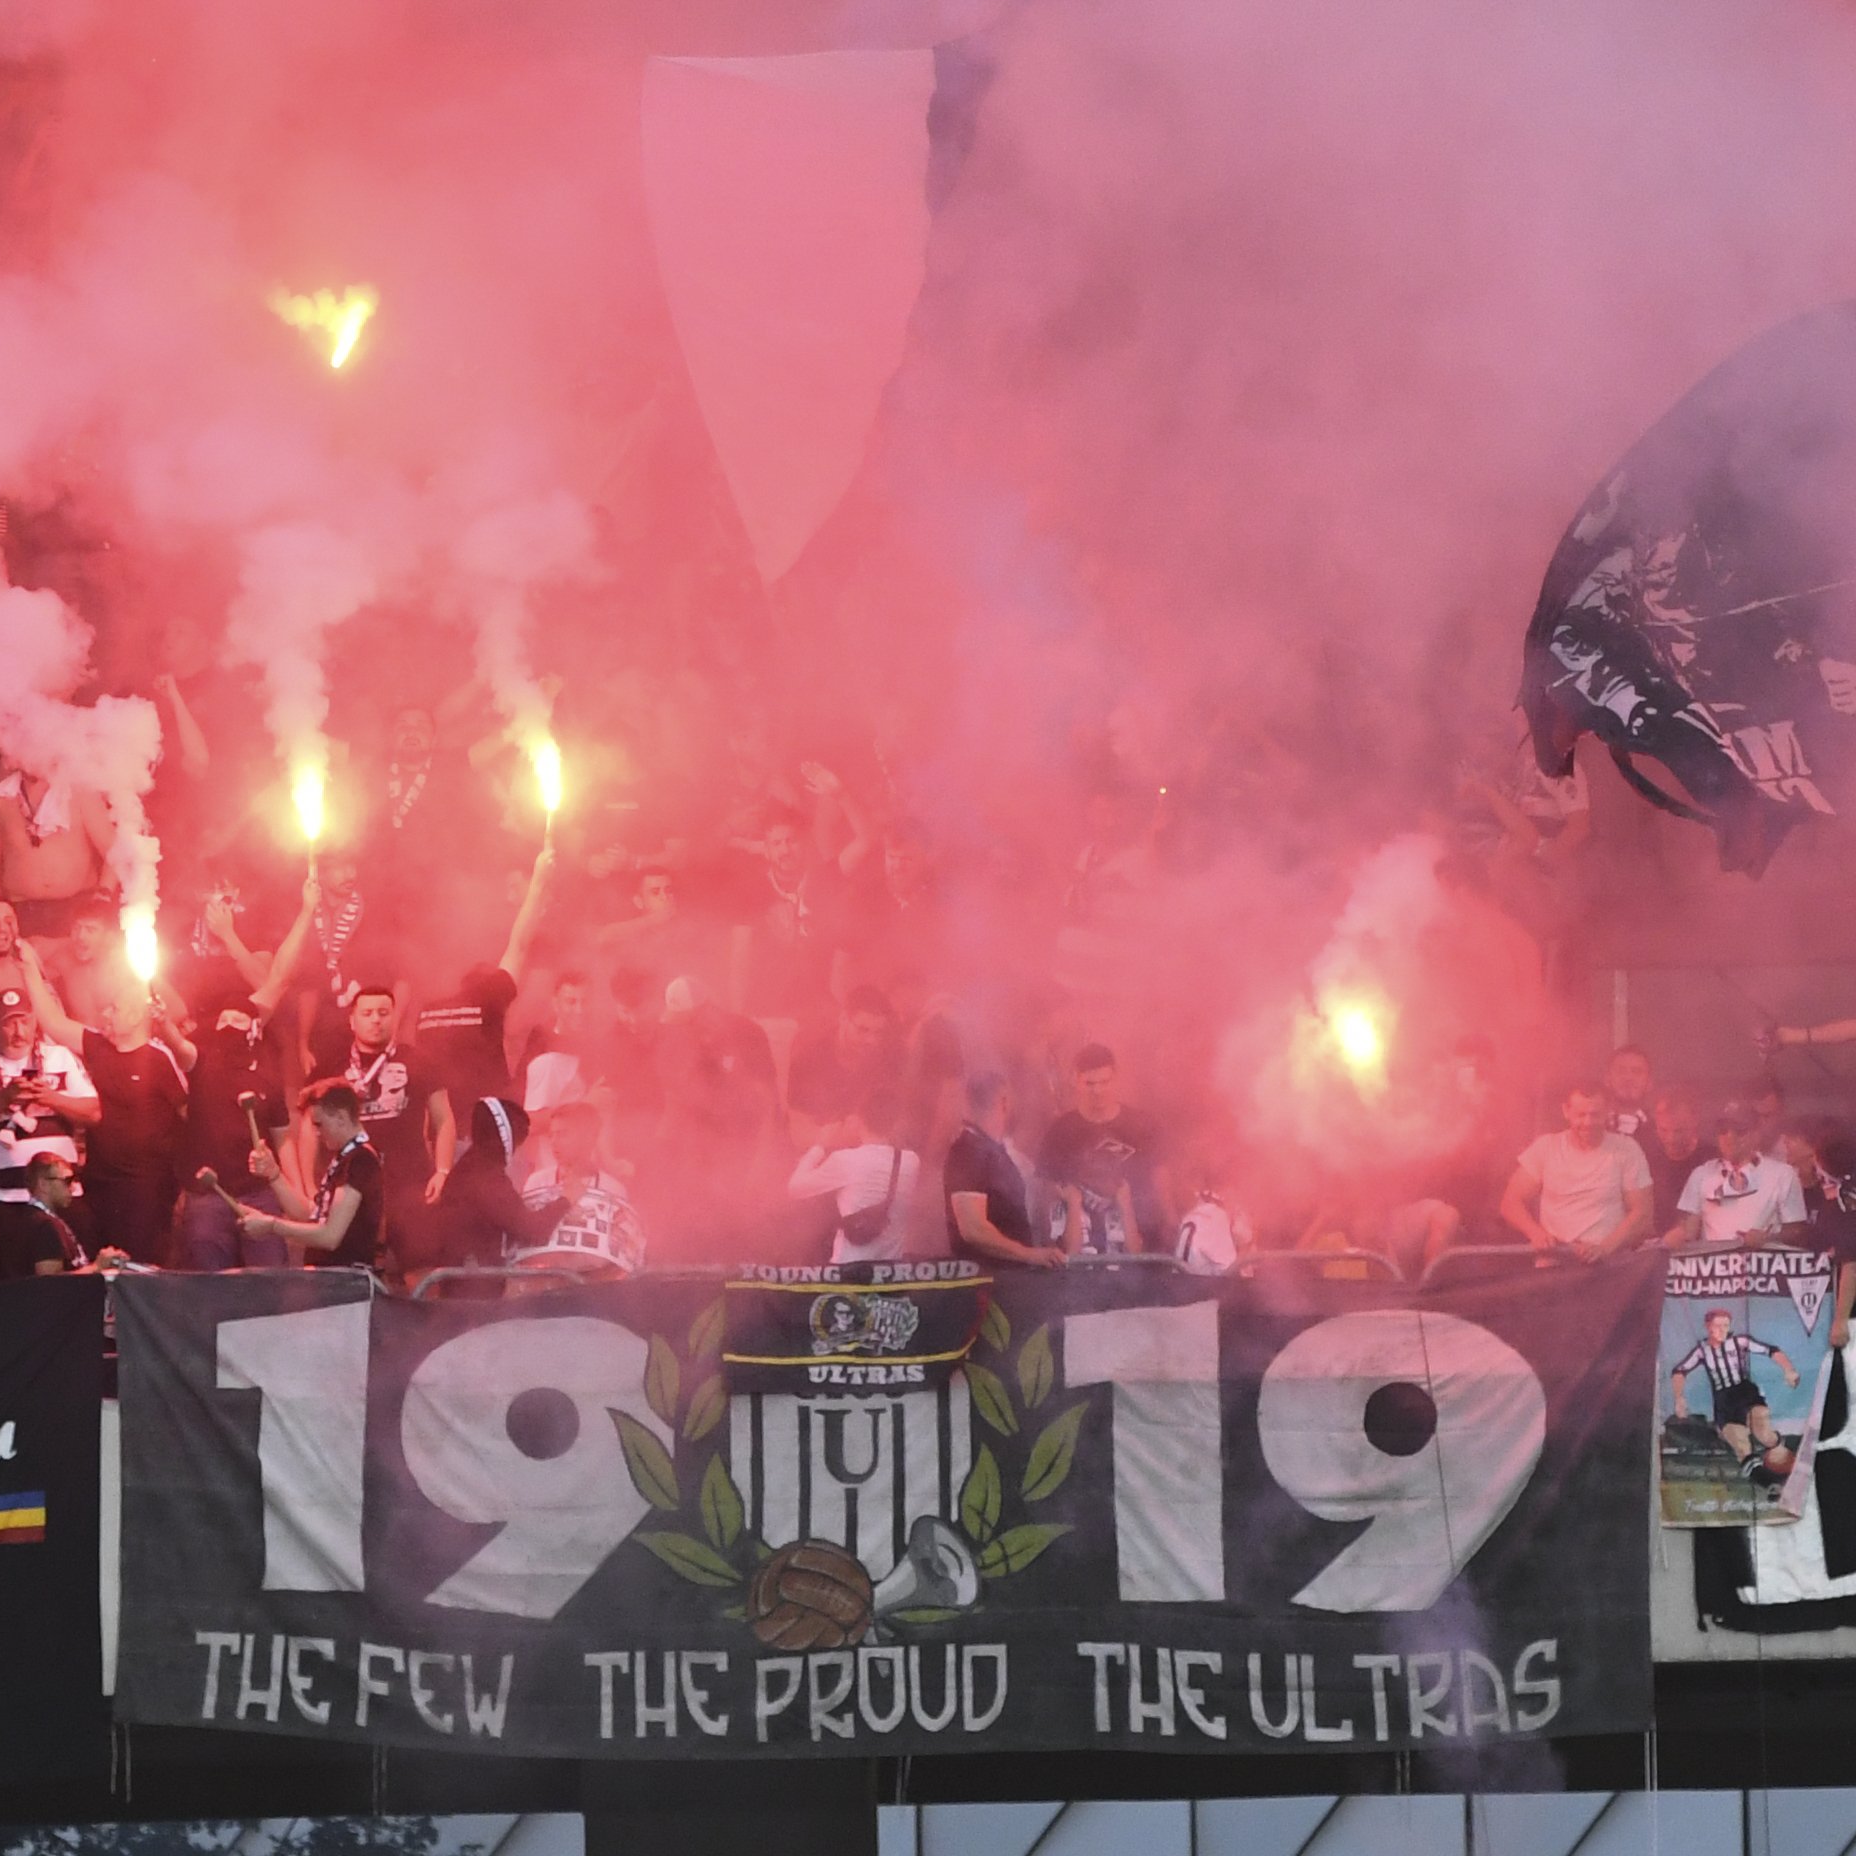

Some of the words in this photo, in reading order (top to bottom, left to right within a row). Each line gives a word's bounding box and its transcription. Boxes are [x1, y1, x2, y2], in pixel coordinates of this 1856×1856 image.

[739, 1263, 842, 1284] YOUNG
[871, 1259, 981, 1285] PROUD
[807, 1364, 926, 1386] ULTRAS
[195, 1630, 336, 1724] THE
[356, 1642, 515, 1740] FEW
[583, 1650, 730, 1740] THE
[754, 1643, 1009, 1743] PROUD
[1077, 1641, 1229, 1740] THE
[1246, 1638, 1562, 1742] ULTRAS
